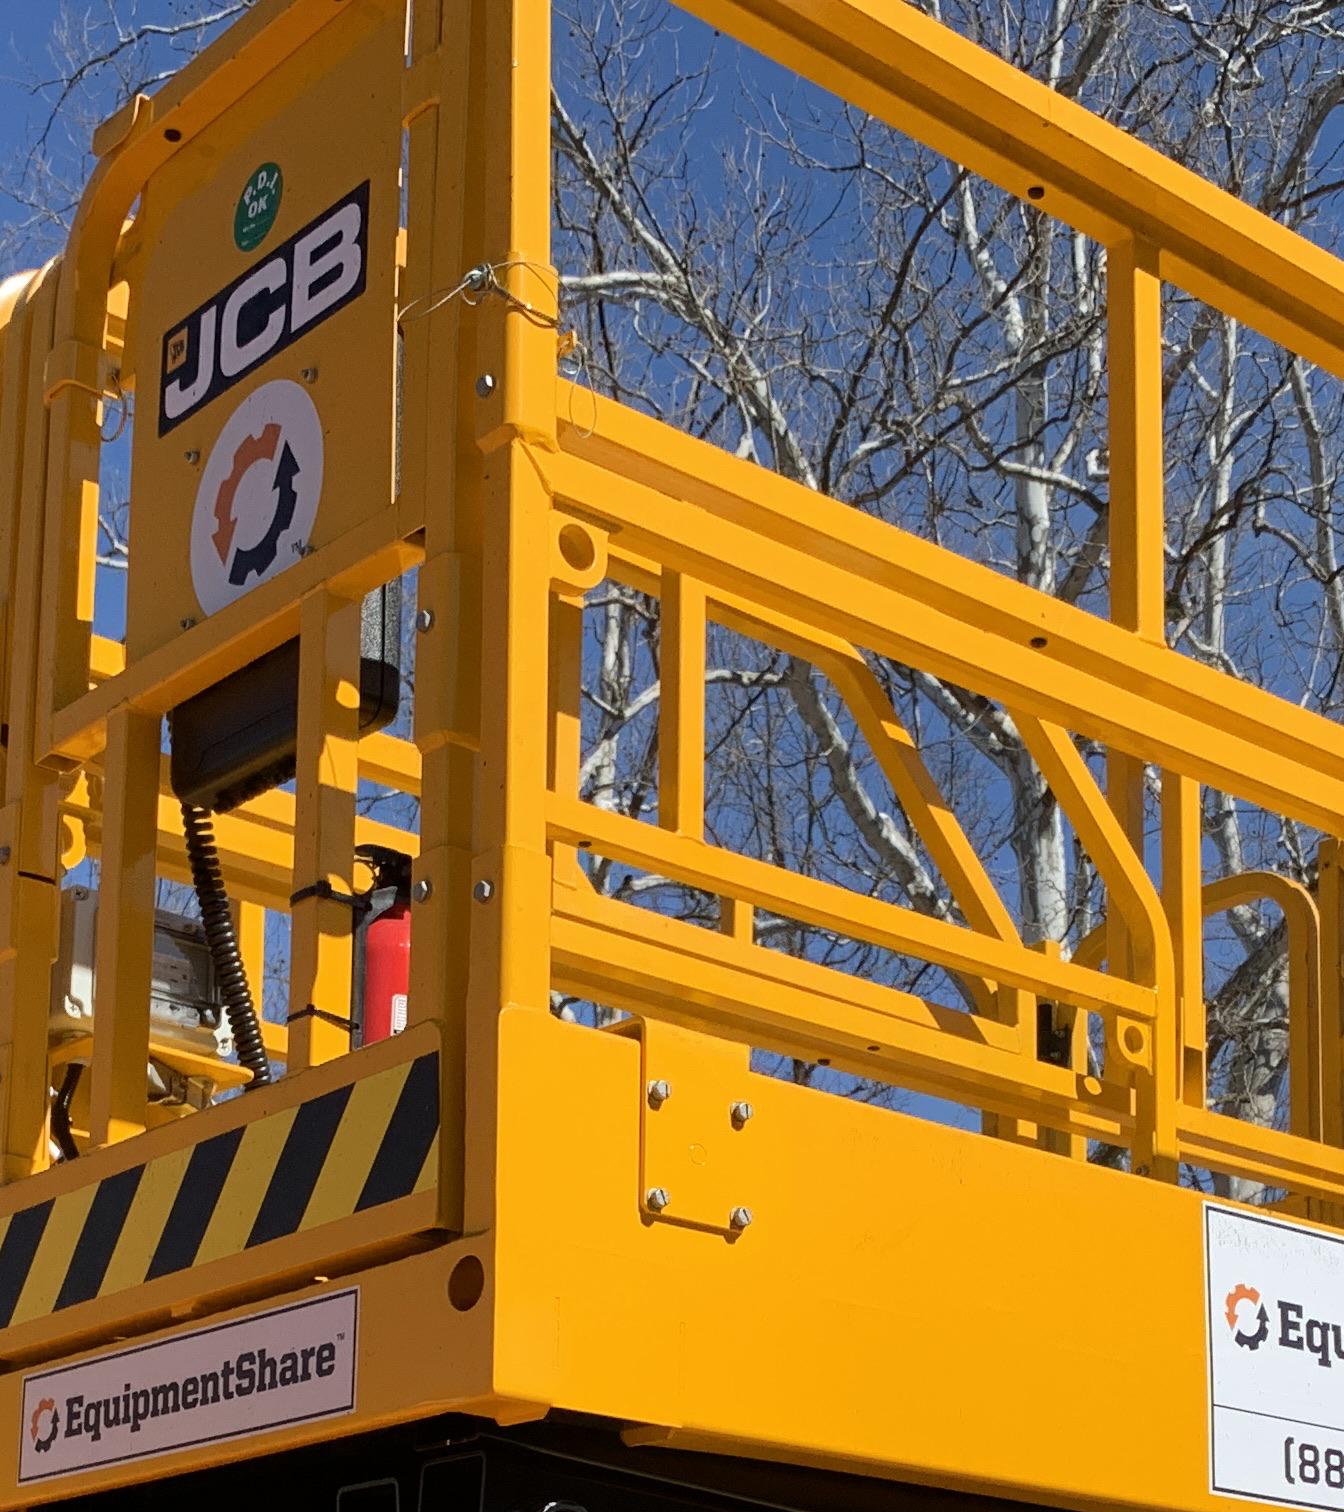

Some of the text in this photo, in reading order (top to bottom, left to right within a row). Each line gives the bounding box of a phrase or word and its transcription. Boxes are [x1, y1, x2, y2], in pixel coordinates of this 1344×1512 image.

[248, 194, 269, 218] OK
[164, 203, 362, 420] JCB
[64, 1341, 336, 1442] EquipmentShare
